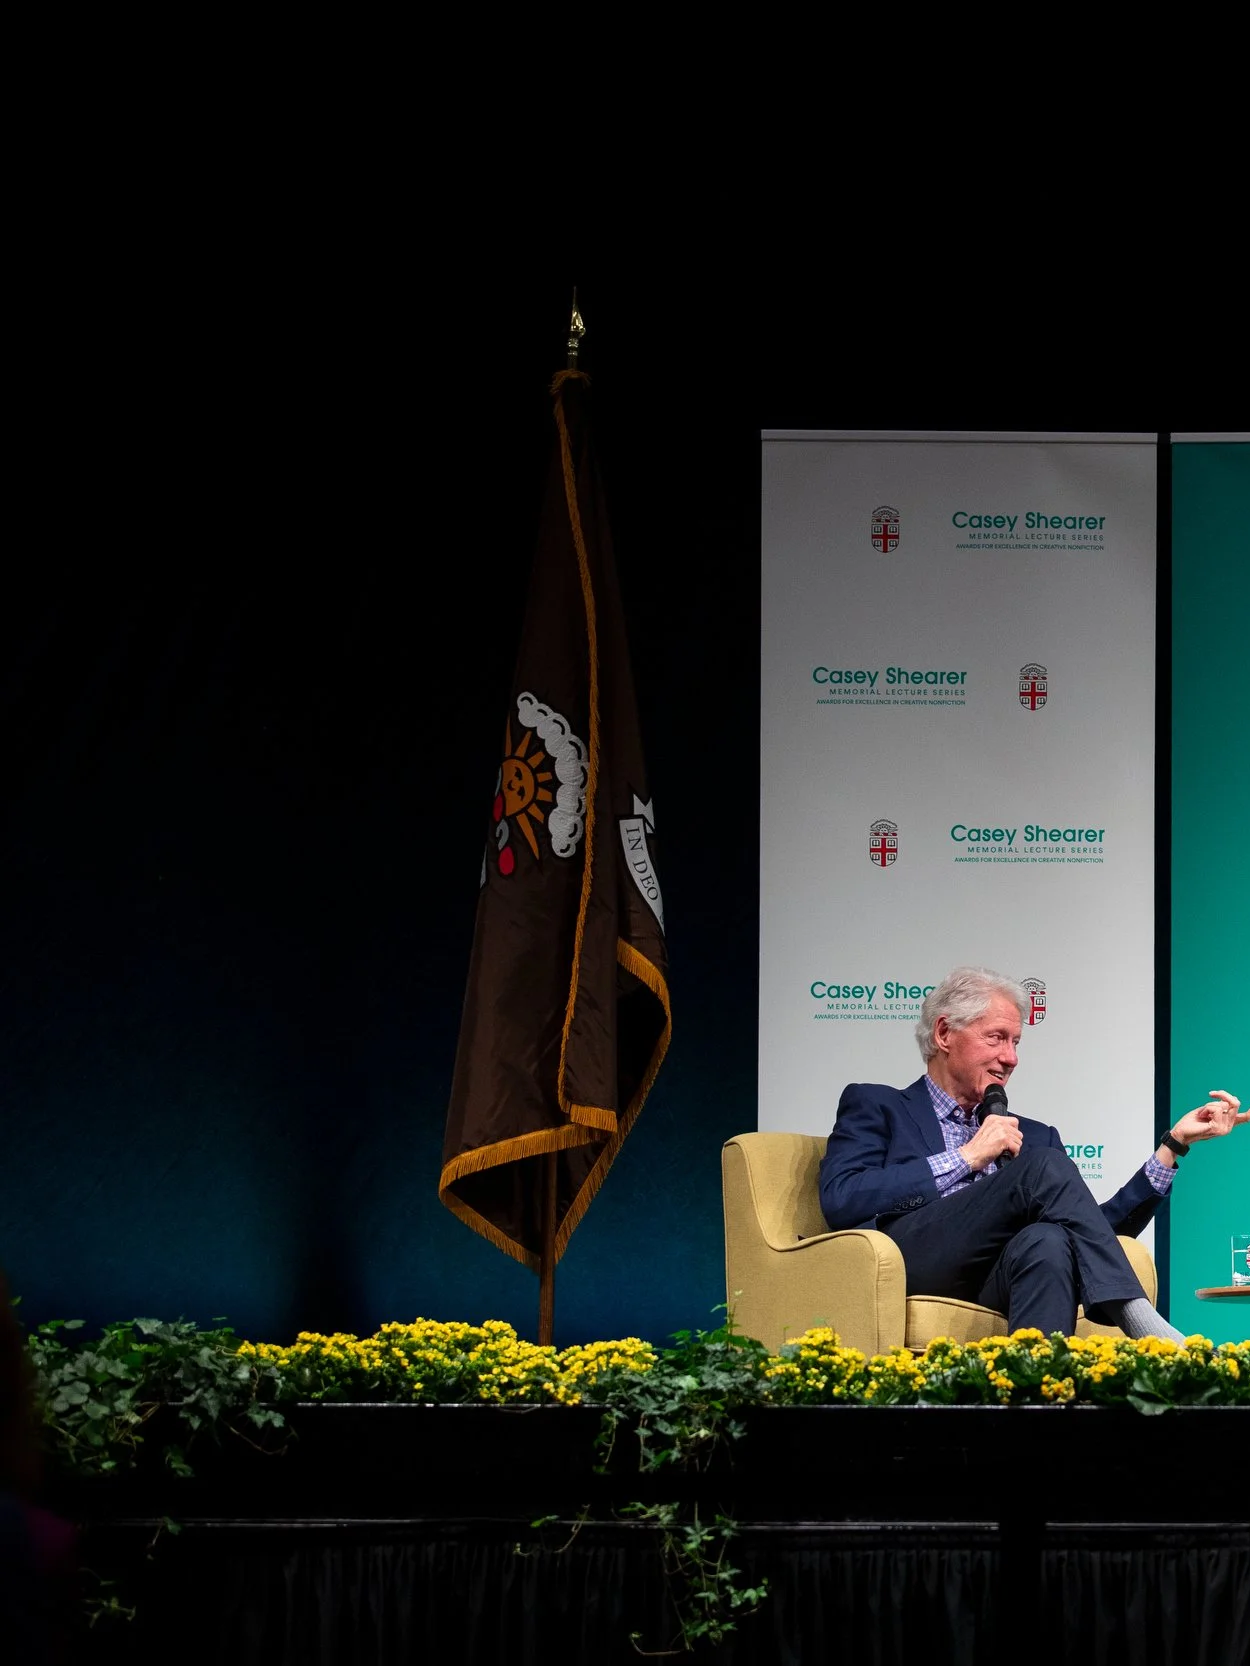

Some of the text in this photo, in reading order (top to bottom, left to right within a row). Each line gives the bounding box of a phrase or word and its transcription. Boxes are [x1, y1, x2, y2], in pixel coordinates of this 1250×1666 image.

[952, 512, 1106, 531] Casey Shearer
[813, 667, 967, 687] Casey Shearer
[951, 825, 1105, 845] Casey Shearer
[626, 827, 658, 901] IN DEO
[810, 981, 936, 1002] Casey Shea
[1064, 1144, 1104, 1158] arer
